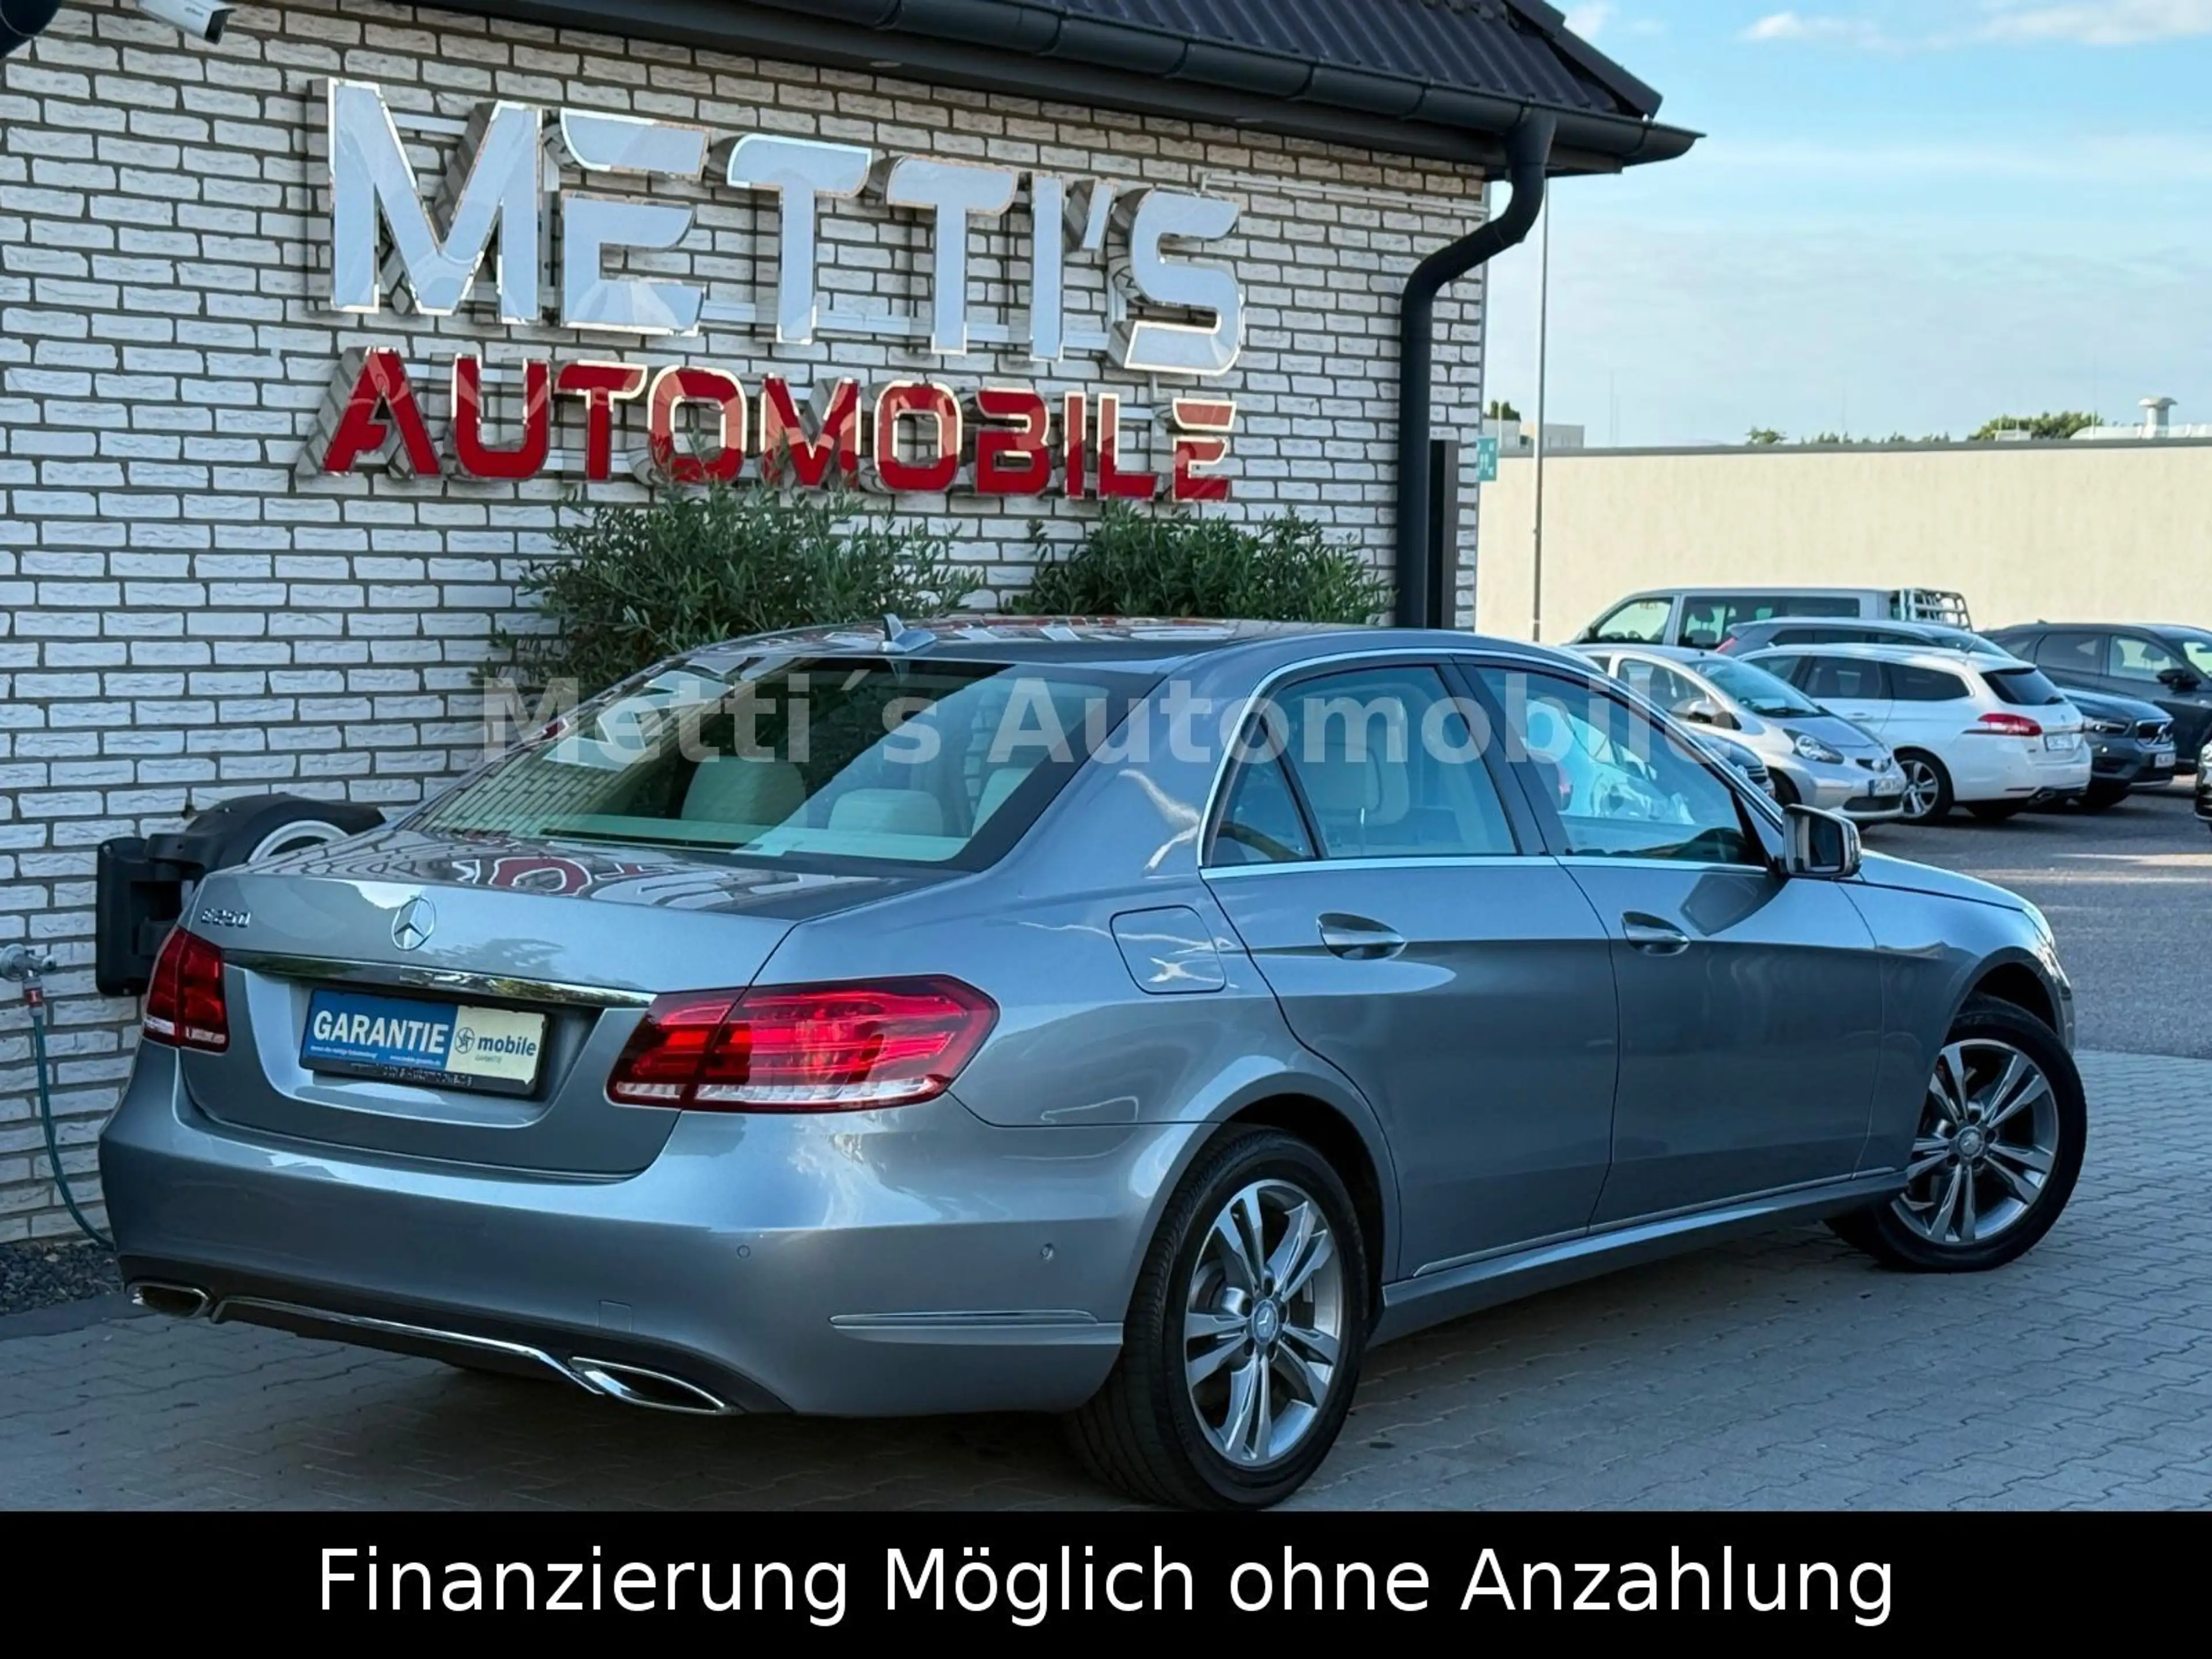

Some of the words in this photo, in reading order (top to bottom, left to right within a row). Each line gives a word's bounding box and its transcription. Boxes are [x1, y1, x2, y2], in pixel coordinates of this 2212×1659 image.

[326, 78, 1247, 376] METTI'S
[323, 346, 1237, 501] AUTOMOBILE
[313, 1010, 449, 1054] GARANTIE
[478, 1035, 537, 1056] mobile
